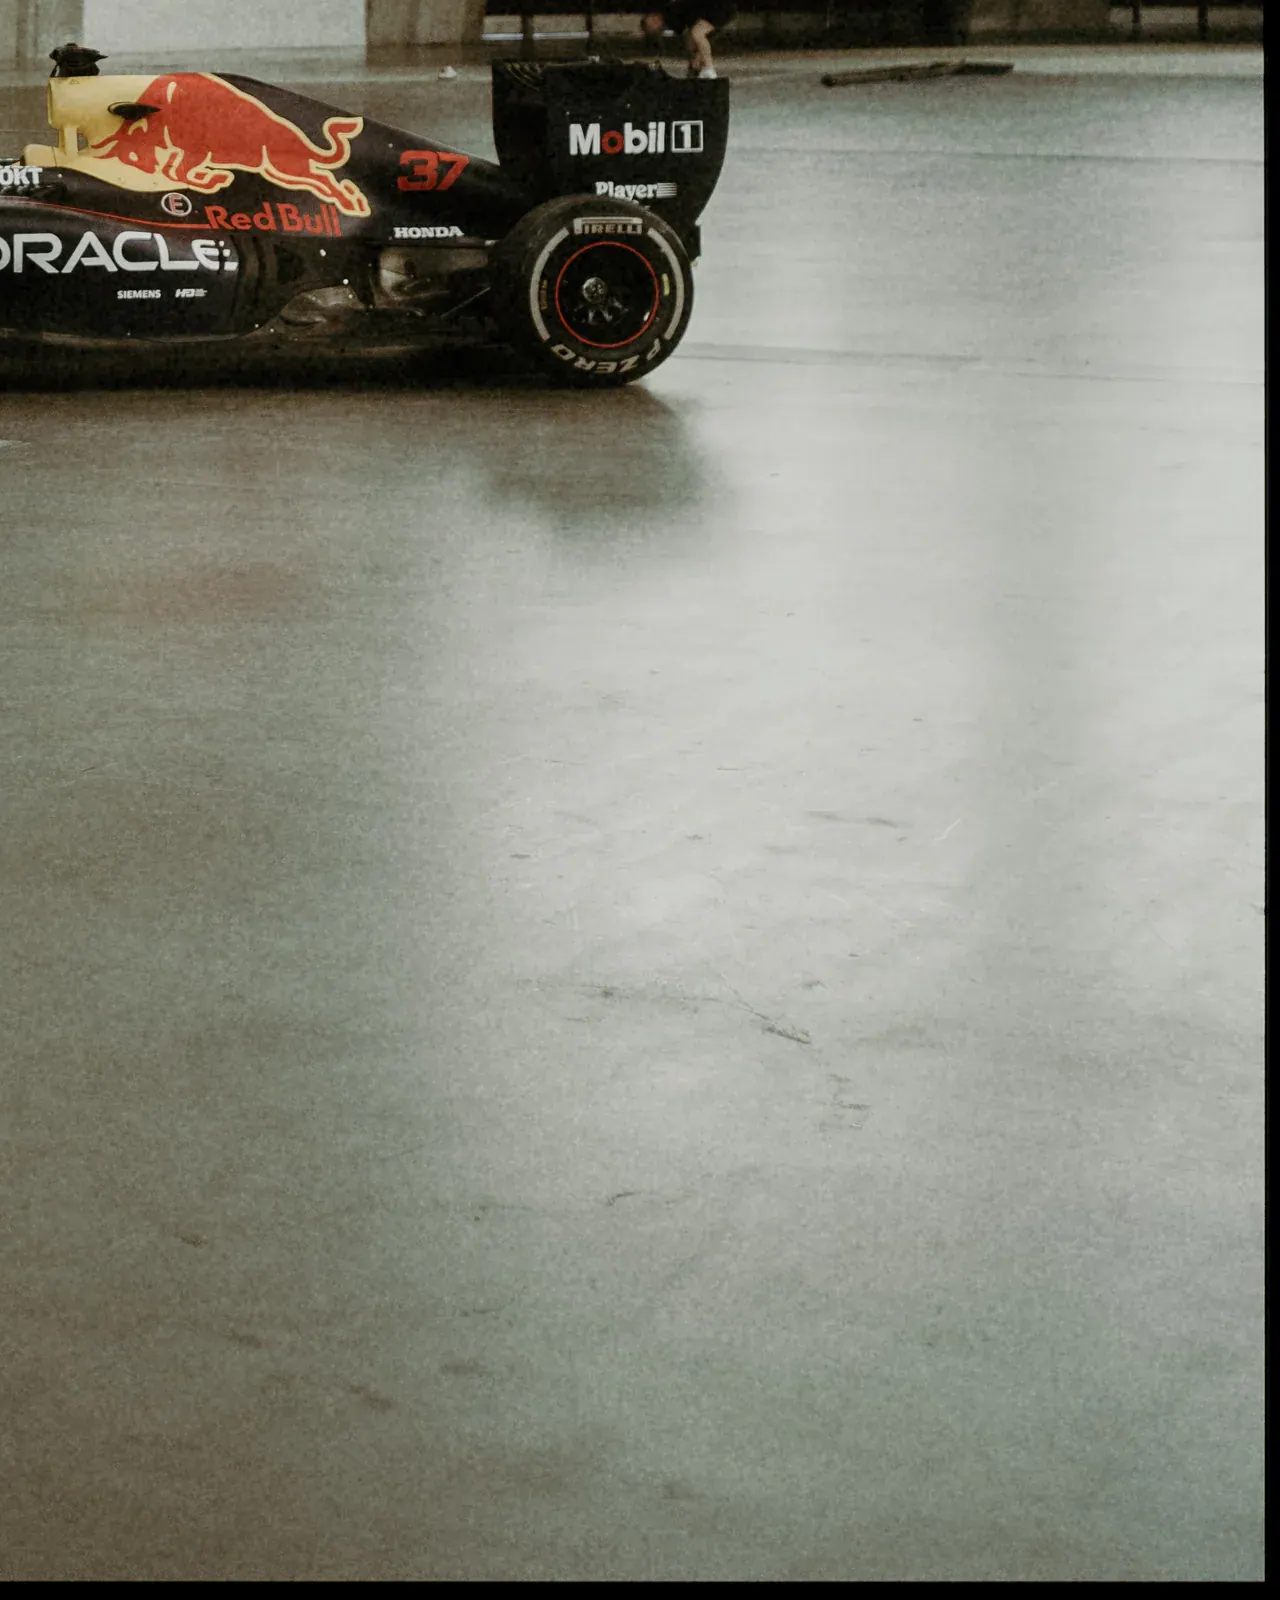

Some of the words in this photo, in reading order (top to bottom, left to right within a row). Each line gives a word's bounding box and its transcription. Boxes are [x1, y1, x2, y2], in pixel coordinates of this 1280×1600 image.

[569, 121, 666, 156] Mobil
[397, 150, 469, 191] 37
[204, 202, 276, 230] Red
[277, 203, 342, 237] Bull
[393, 226, 465, 239] HONDA
[573, 216, 643, 235] PIRELLI
[117, 289, 161, 299] SIEMENS
[551, 344, 640, 374] ZERO
[646, 338, 661, 361] P
